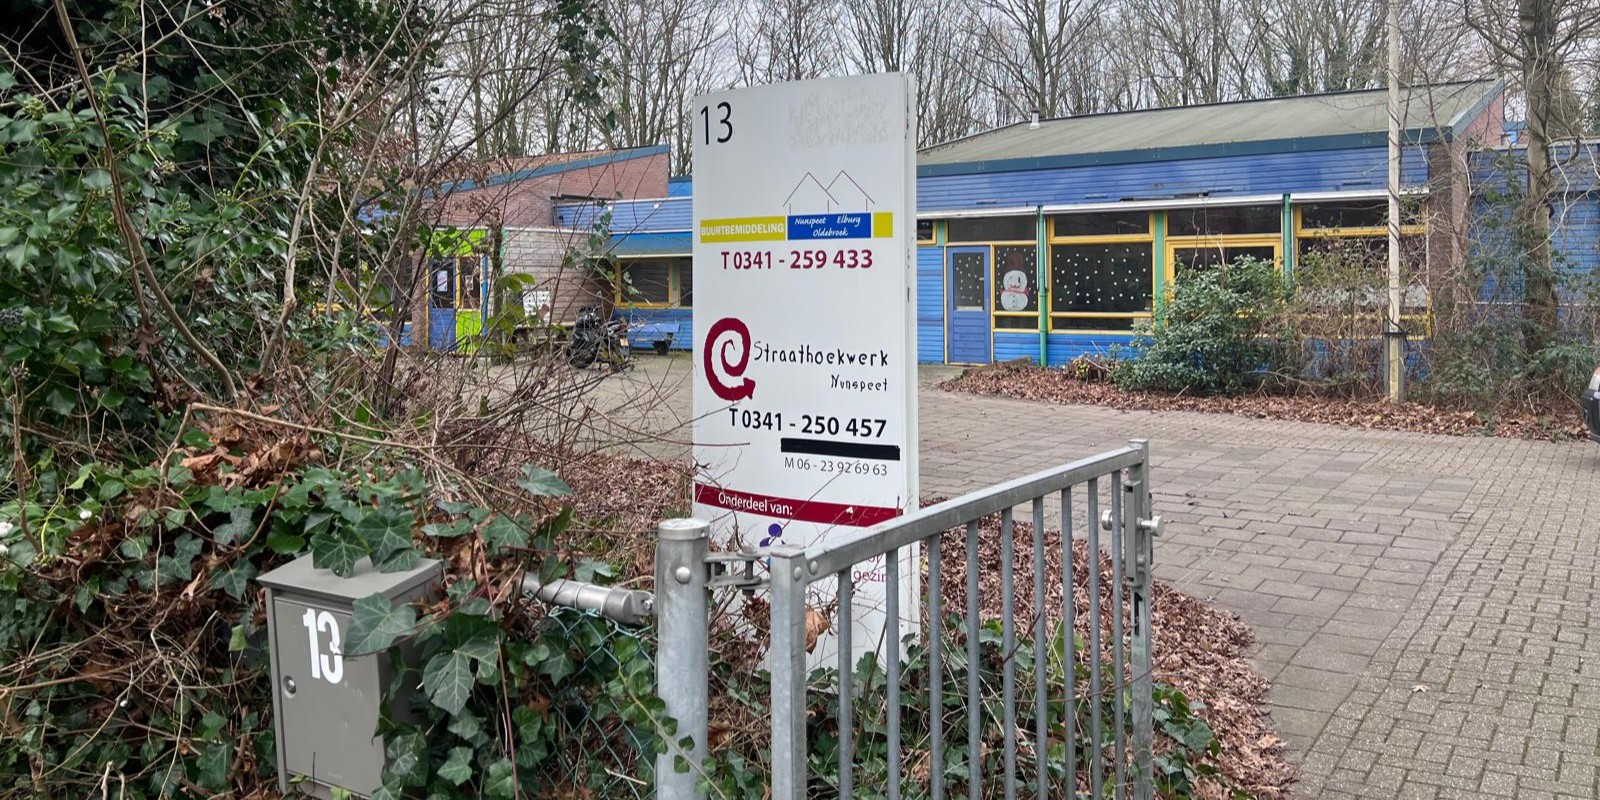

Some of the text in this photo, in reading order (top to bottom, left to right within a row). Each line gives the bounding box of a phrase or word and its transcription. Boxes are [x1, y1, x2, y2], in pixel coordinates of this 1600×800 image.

[700, 101, 733, 145] 13
[701, 223, 784, 236] BUURTBEMIDDELING
[795, 215, 861, 228] Nunspeet Elburg
[813, 228, 848, 237] Oldebroek
[721, 252, 729, 269] T
[733, 252, 771, 269] 0341
[790, 250, 827, 269] 259
[833, 250, 873, 269] 433
[753, 341, 888, 366] Straathoekwerk
[831, 375, 887, 392] Nunspeet
[729, 409, 738, 426] T
[742, 410, 782, 431] 0341
[801, 415, 840, 435] 250
[845, 419, 887, 437] 457
[784, 457, 794, 468] M
[797, 458, 810, 470] 06
[820, 460, 833, 472] 23
[837, 462, 851, 473] 92
[854, 463, 869, 474] 69
[872, 464, 887, 476] 63
[718, 492, 793, 516] Onderdeel van:
[302, 608, 344, 684] 13
